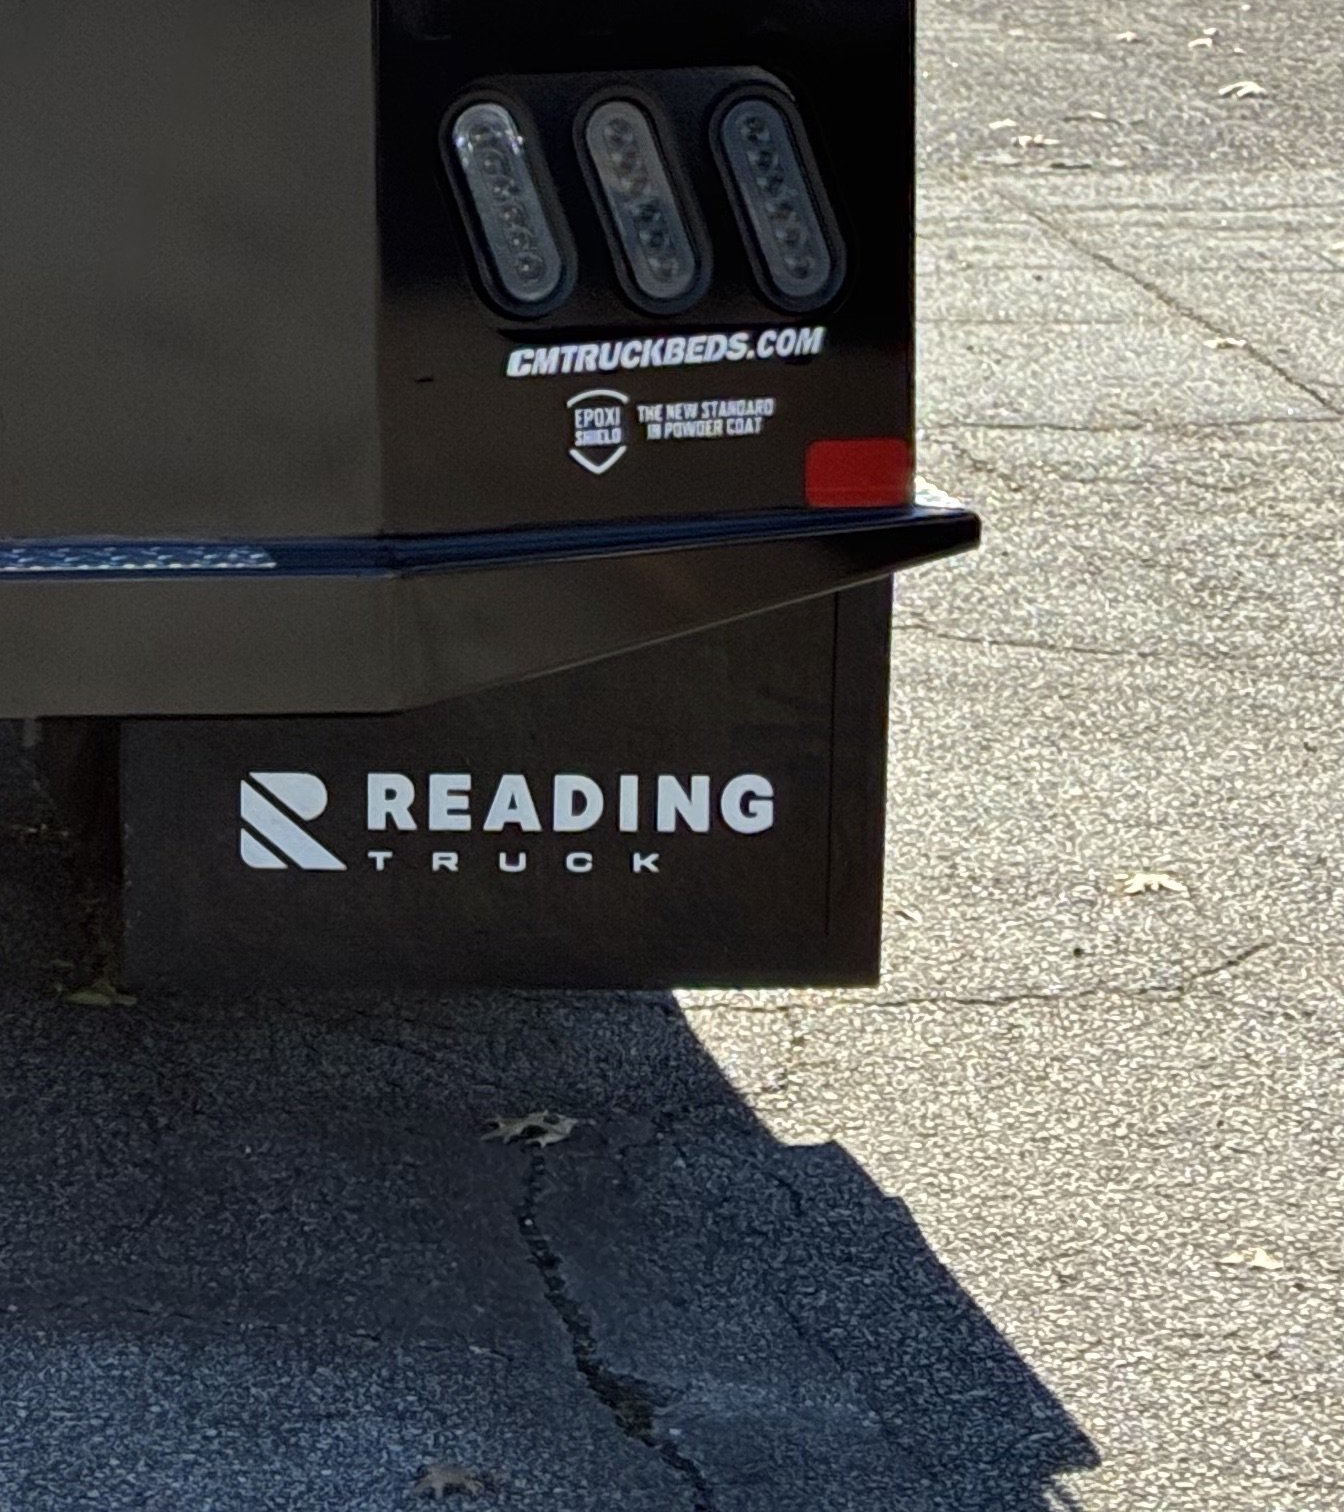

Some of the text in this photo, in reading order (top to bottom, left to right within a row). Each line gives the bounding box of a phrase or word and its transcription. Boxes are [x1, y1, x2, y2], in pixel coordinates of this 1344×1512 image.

[505, 326, 826, 378] CMTRUCKBEDS.COM
[574, 406, 622, 429] EPOXI
[636, 397, 776, 424] THE NEW STANDARD
[574, 427, 623, 448] SHIELD
[646, 415, 764, 441] IN POWDER COAT
[367, 772, 775, 835] READING
[367, 850, 661, 873] TRUCK
